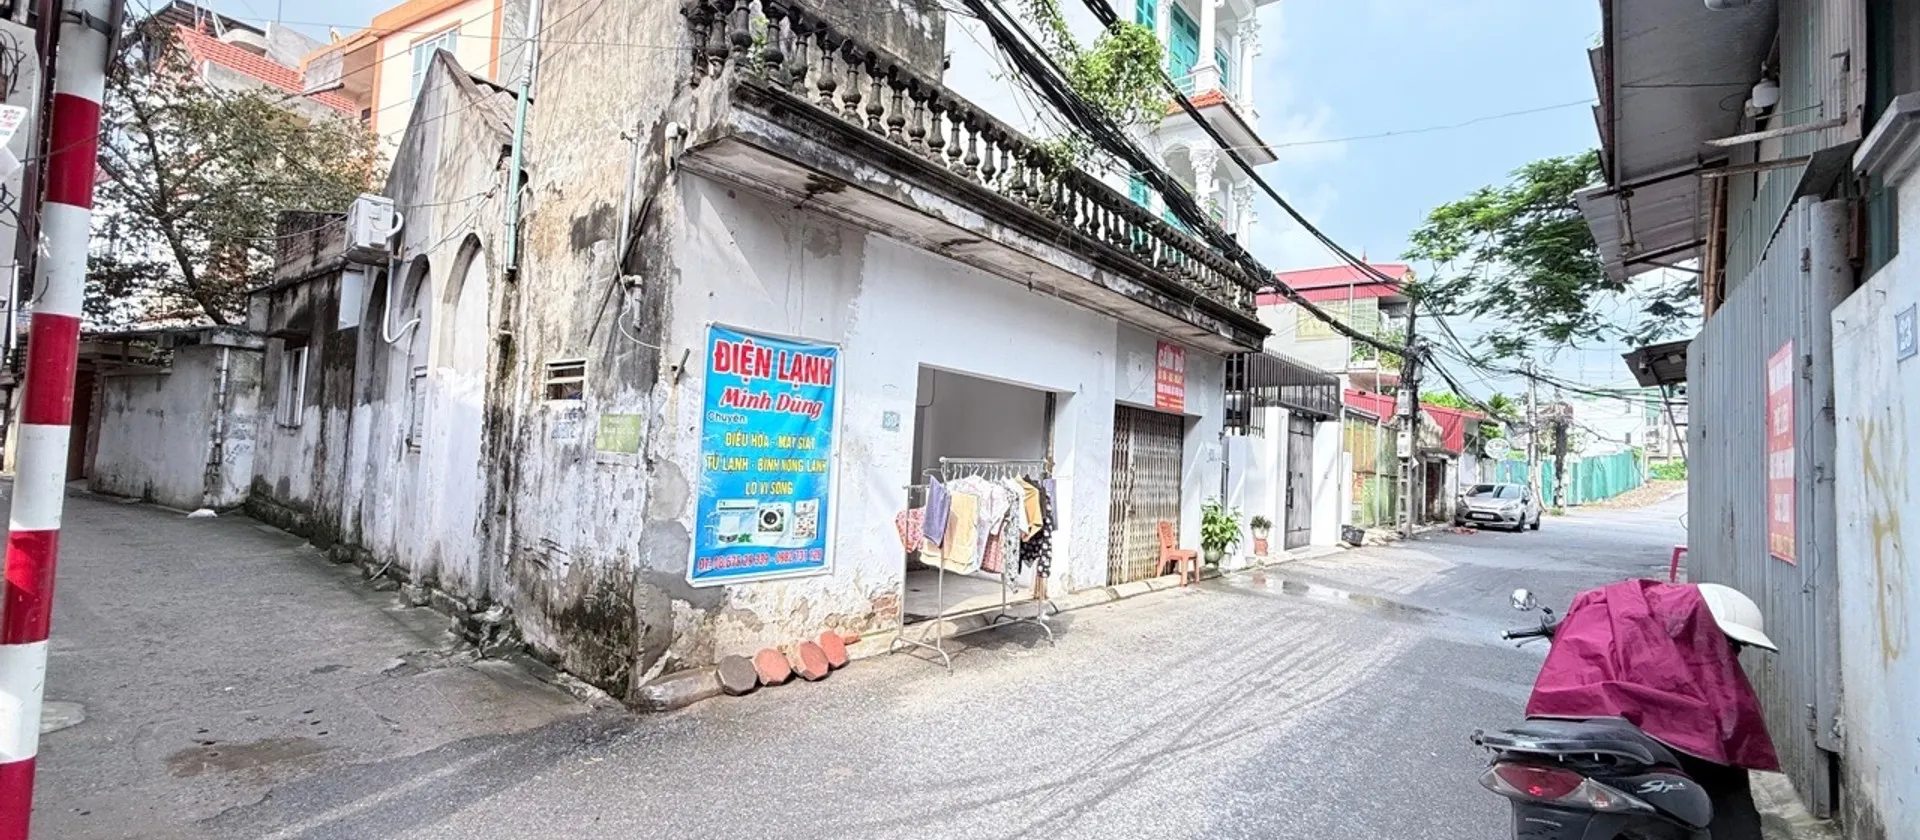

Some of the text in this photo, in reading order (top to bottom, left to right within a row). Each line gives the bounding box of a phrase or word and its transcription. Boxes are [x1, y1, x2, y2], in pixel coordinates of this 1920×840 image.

[1898, 314, 1912, 351] 23
[715, 339, 832, 388] ĐIỆN LẠNH
[708, 411, 745, 423] Chuyên
[720, 388, 823, 419] Minh Dũng
[722, 456, 749, 474] LẠNH
